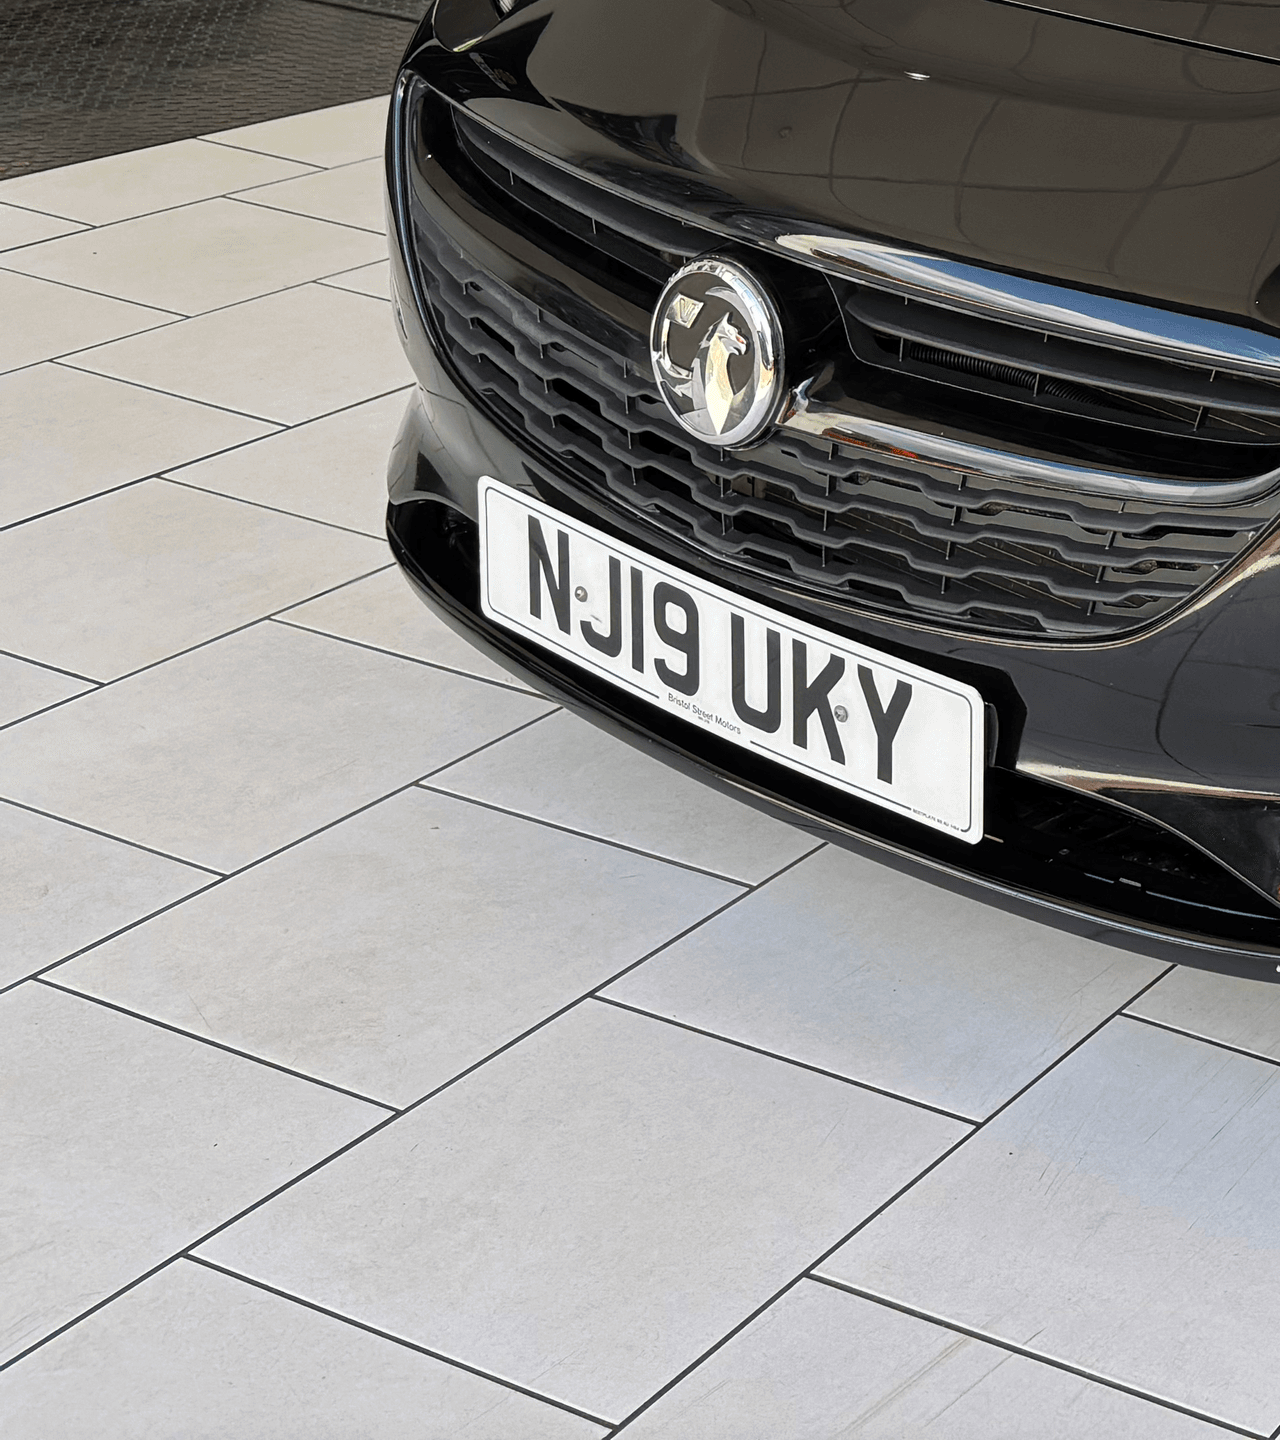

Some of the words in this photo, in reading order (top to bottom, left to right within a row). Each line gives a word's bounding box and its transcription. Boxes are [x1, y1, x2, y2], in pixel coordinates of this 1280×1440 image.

[527, 514, 700, 696] NJ19
[730, 611, 913, 785] UKY
[668, 692, 691, 711] Bristol
[692, 704, 713, 721] Street
[715, 715, 741, 735] Motors
